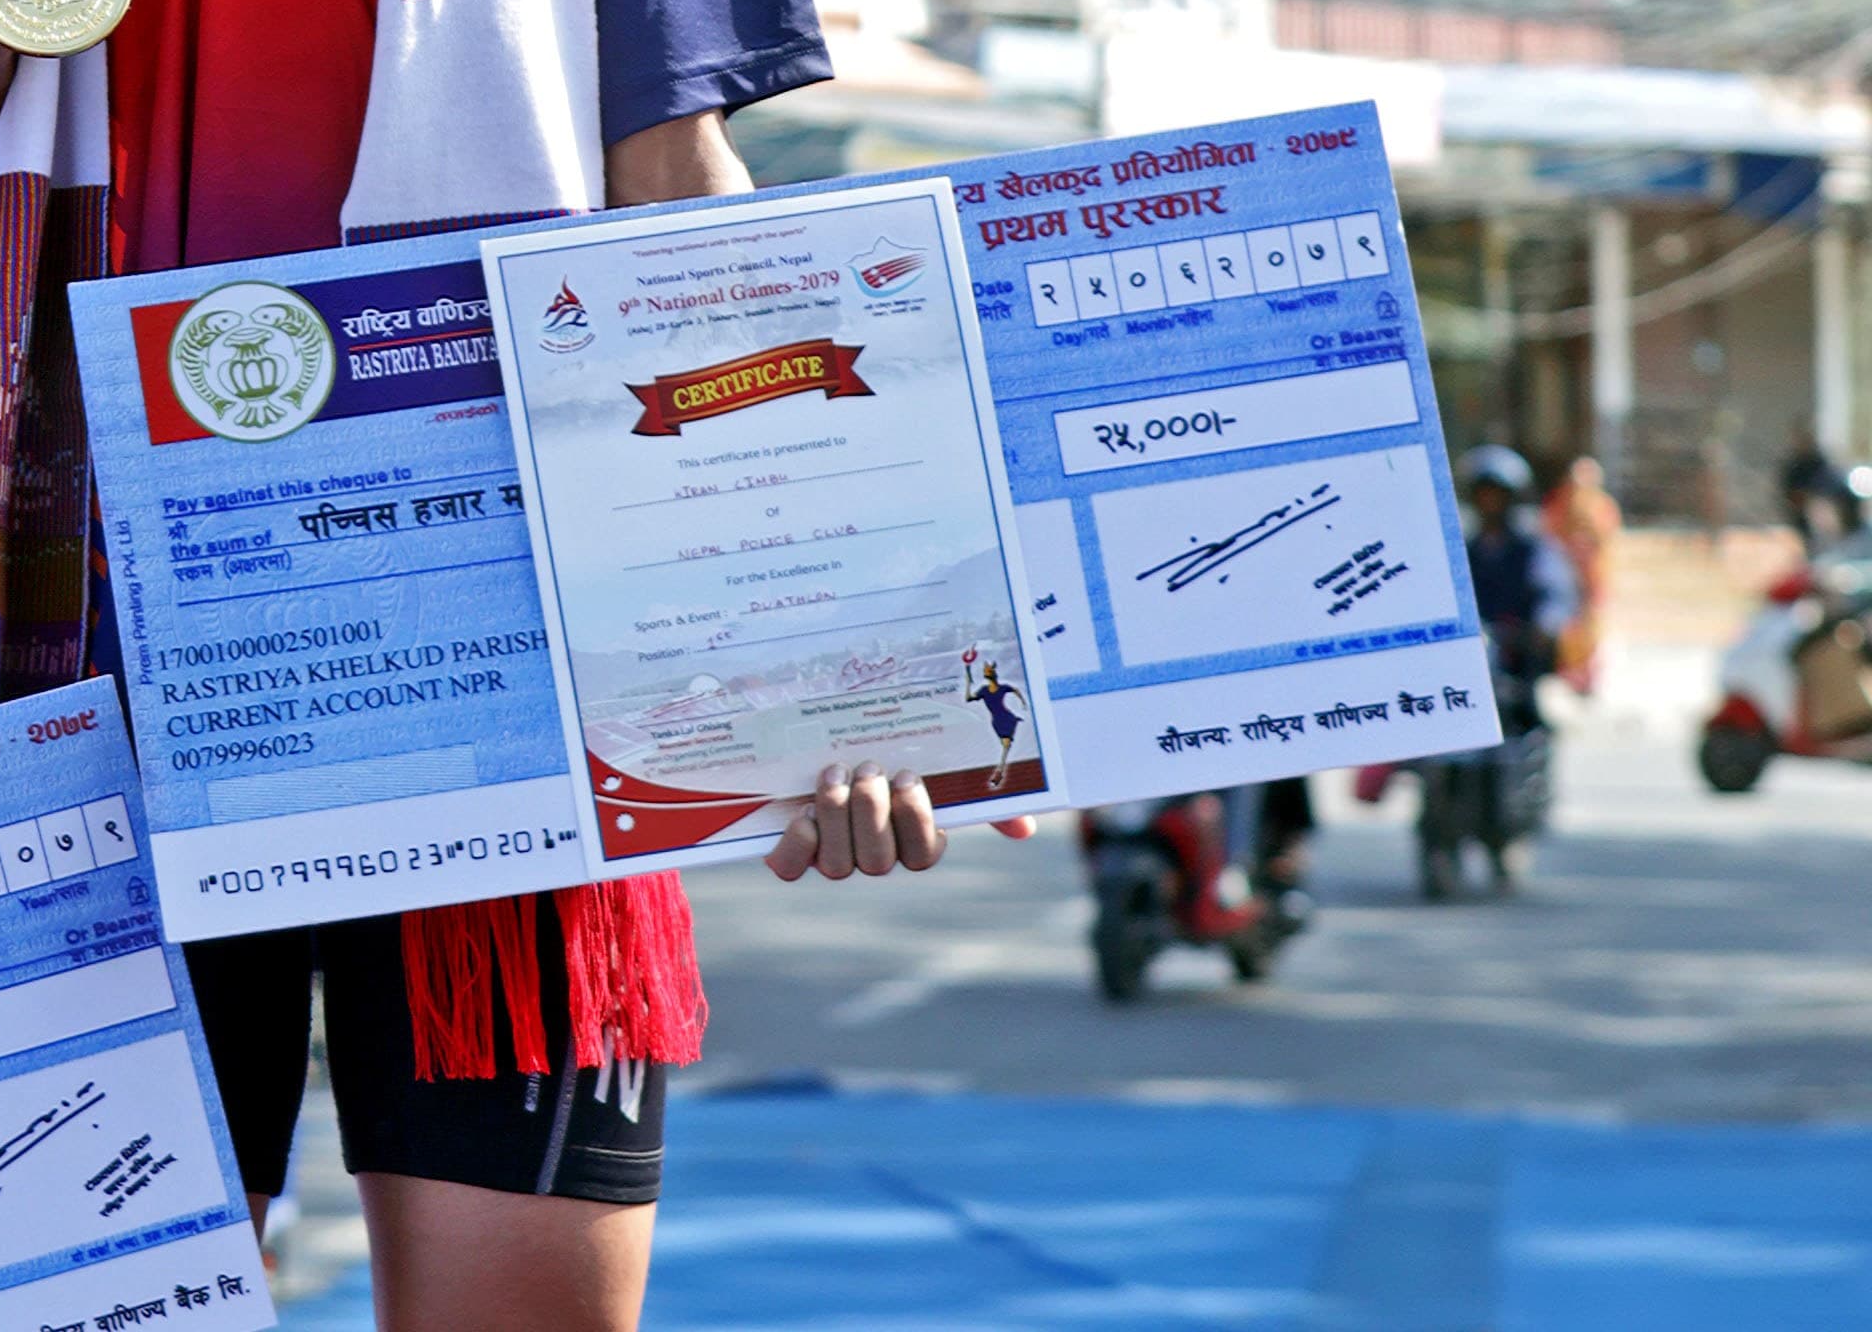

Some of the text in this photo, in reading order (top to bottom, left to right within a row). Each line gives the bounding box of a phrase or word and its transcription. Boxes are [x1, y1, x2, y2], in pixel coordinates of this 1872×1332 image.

[995, 164, 1102, 201] खेलकुद
[1110, 139, 1256, 186] प्रतियोगिता
[978, 185, 1227, 251] प्रथम पुरस्कार
[636, 269, 686, 288] National
[688, 264, 726, 282] Sports
[778, 251, 813, 269] Nepal
[618, 269, 841, 318] 9th National Games-2079
[341, 308, 411, 339] राष्ट्रिय
[1051, 322, 1111, 347] Day/गते
[1310, 325, 1405, 350] Or Bearer
[348, 341, 430, 382] RASTRIYA
[432, 332, 500, 368] BANIJYA
[672, 355, 825, 411] CERTIFICATE
[677, 435, 847, 471] This certificate is presented to
[161, 466, 414, 517] Pay against this cheque to
[166, 520, 189, 543] श्री
[298, 500, 398, 543] पच्चिस
[412, 489, 486, 526] हजार
[169, 529, 273, 560] the sum of
[173, 560, 215, 584] रकम
[725, 563, 829, 586] For the Excellence
[129, 581, 148, 641] Printing
[634, 619, 673, 634] Sports
[138, 643, 154, 686] Prem
[156, 618, 384, 671] 1700100002501001
[161, 666, 300, 706] RASTRIYA
[307, 644, 445, 686] KHELKUD
[166, 668, 508, 738] CURRENT ACCOUNT NPR
[1241, 713, 1306, 744] राष्ट्रिय
[1316, 699, 1389, 731] वाणिज्य
[1442, 685, 1477, 713] लि.
[171, 731, 315, 771] 0079996023
[16, 882, 91, 911] Year/साल
[64, 910, 156, 947] Or Bearer
[94, 1297, 167, 1332] वाणिज्य
[216, 1273, 251, 1301] लि.
